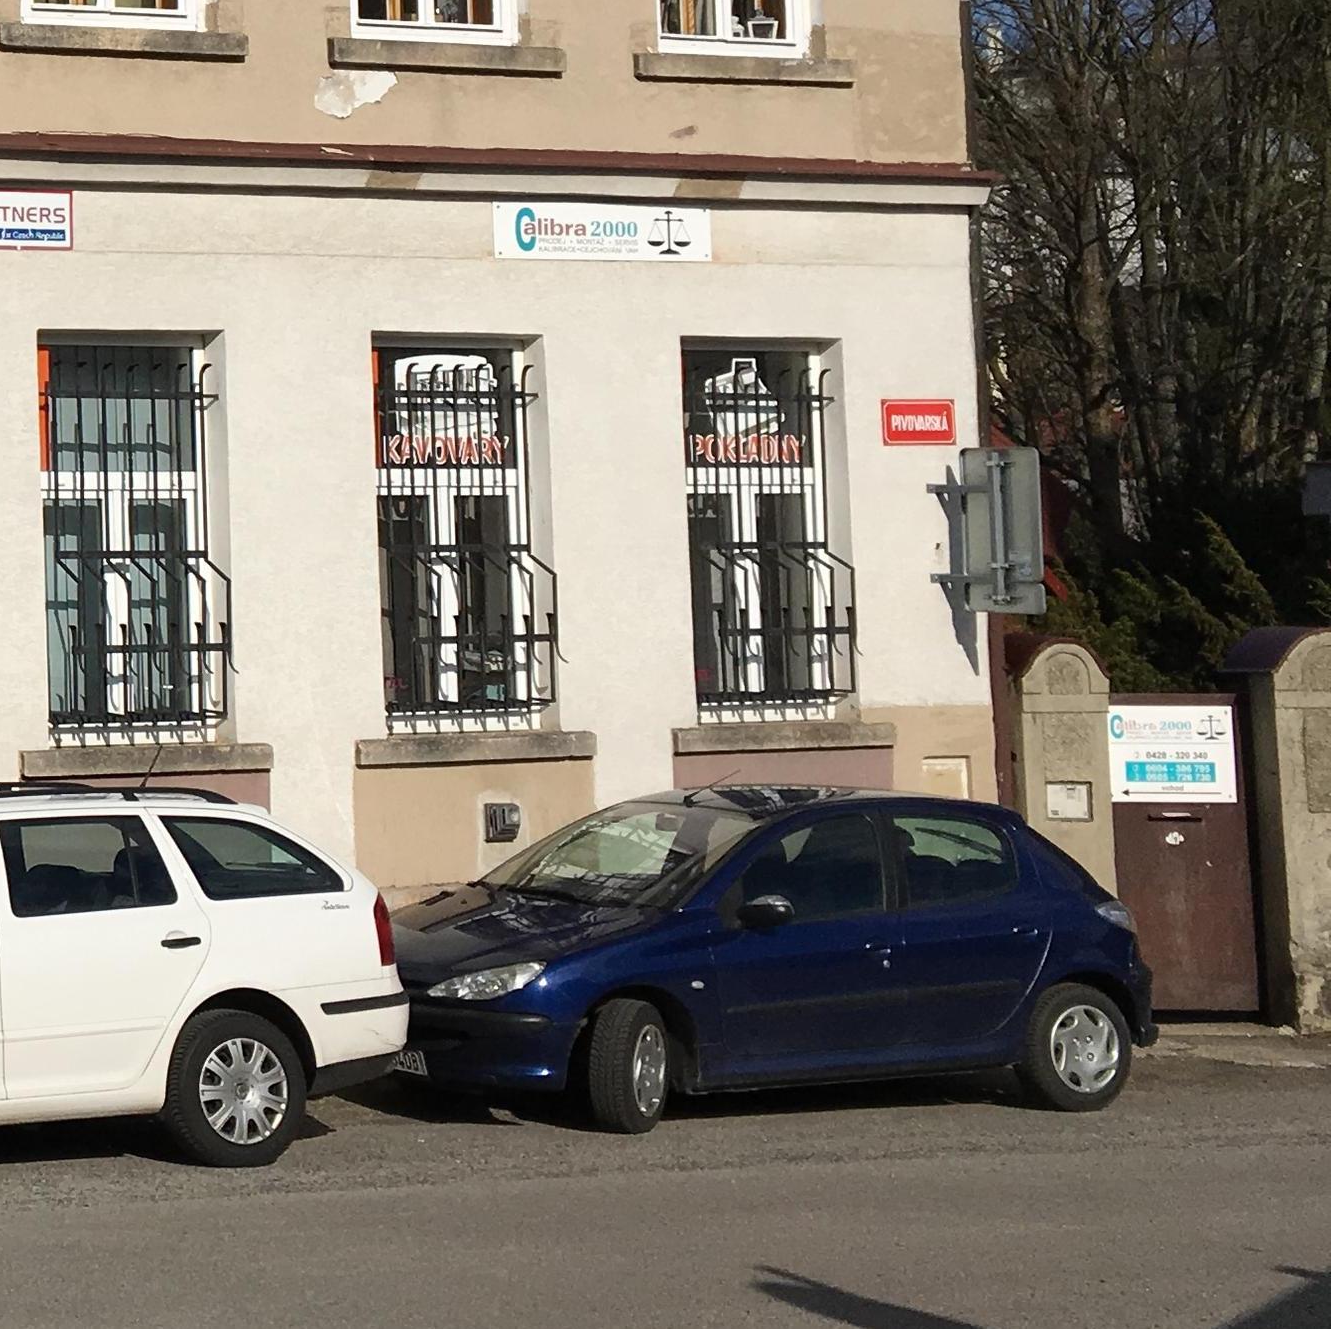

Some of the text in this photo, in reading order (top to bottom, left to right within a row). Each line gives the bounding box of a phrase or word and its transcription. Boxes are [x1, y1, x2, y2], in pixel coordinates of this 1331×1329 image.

[590, 220, 638, 238] 2000
[891, 411, 949, 431] PIVOVARSKÁ
[1159, 721, 1192, 730] 2000
